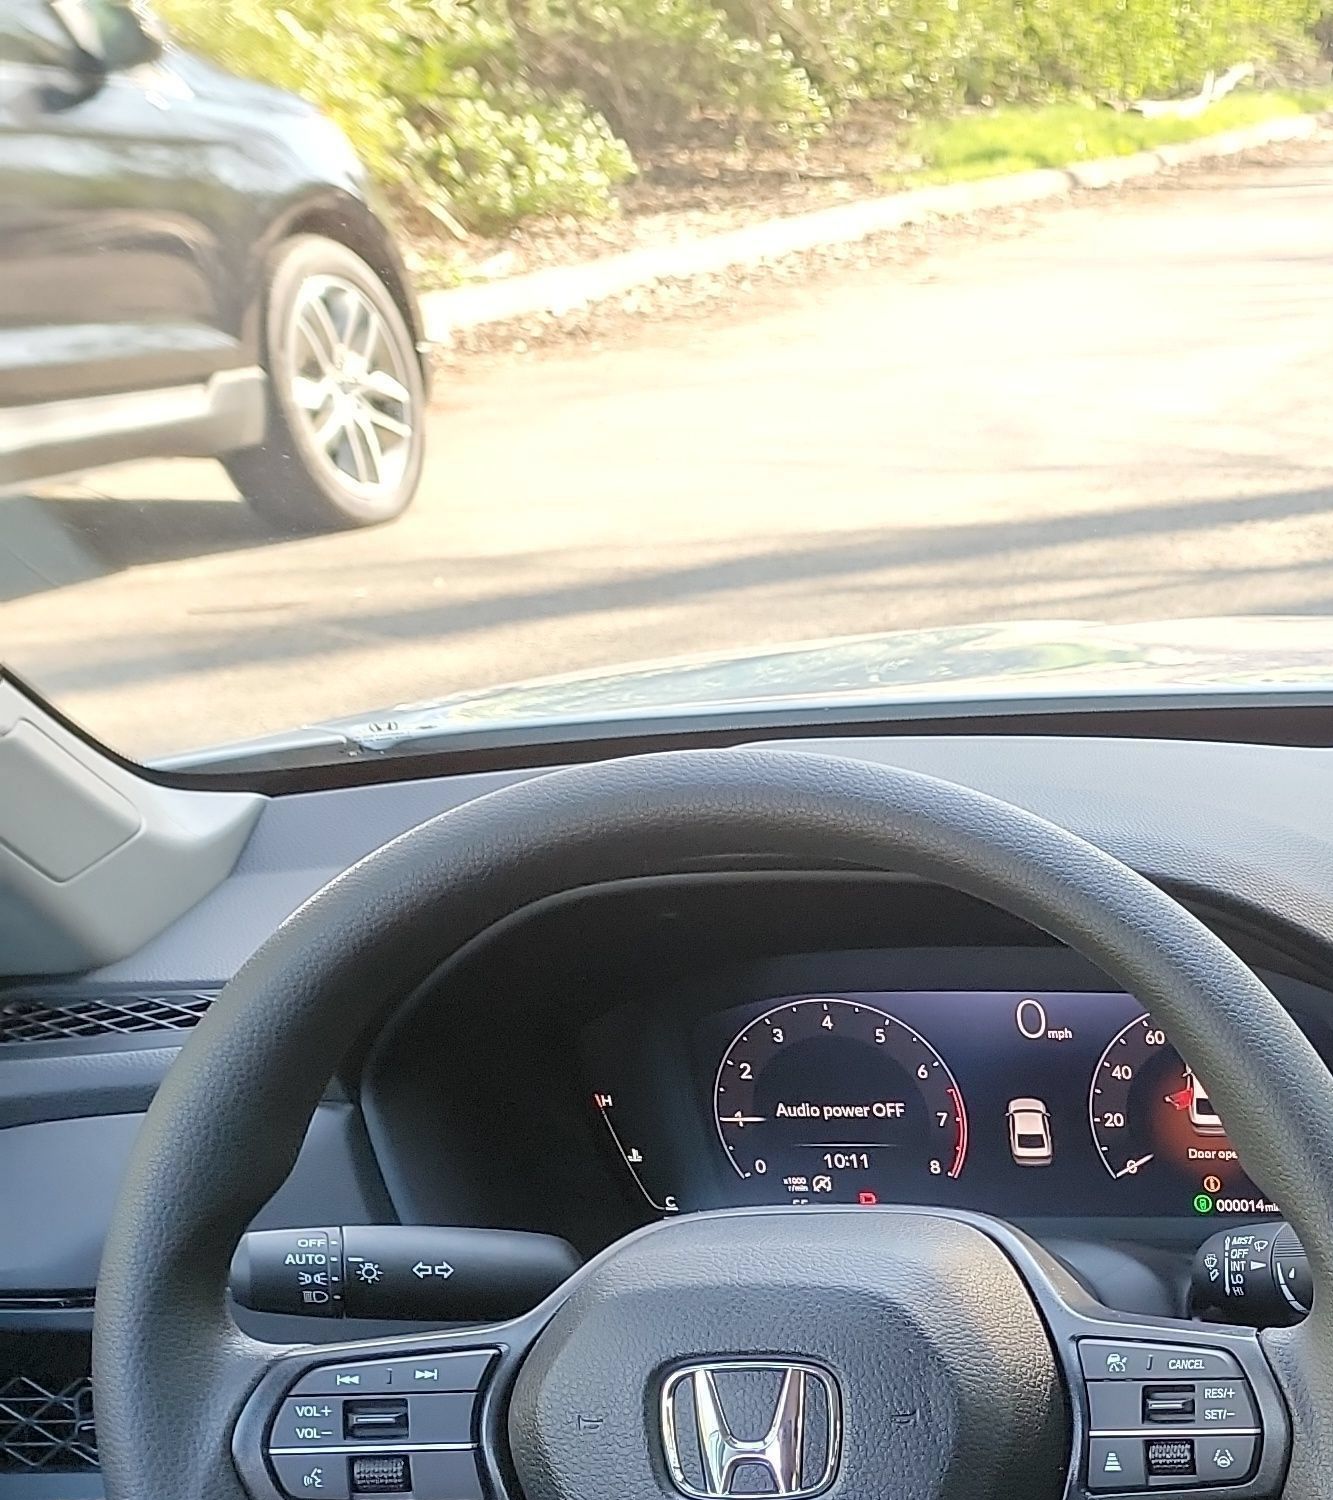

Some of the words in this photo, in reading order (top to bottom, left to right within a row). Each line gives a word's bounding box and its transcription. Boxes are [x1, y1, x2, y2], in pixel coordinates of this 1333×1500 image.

[821, 1015, 833, 1030] 4
[1015, 999, 1046, 1039] 0
[1047, 1028, 1073, 1041] mph
[772, 1028, 784, 1043] 3
[874, 1028, 886, 1043] 5
[1145, 1030, 1166, 1045] 60
[739, 1063, 753, 1079] 2
[917, 1064, 929, 1079] 6
[1111, 1065, 1133, 1080] 40
[601, 1095, 613, 1107] H
[775, 1103, 820, 1118] Audio
[823, 1104, 870, 1121] power
[872, 1103, 905, 1118] OFF
[936, 1112, 947, 1127] 7
[1104, 1112, 1125, 1128] 20
[823, 1153, 869, 1169] 10:11
[1187, 1148, 1216, 1159] Door
[754, 1159, 767, 1174] 0
[930, 1160, 941, 1174] 8
[297, 1238, 326, 1248] OFF
[284, 1253, 327, 1266] AUTO
[1230, 1248, 1249, 1259] OFF
[1230, 1260, 1247, 1272] INT
[1230, 1274, 1244, 1285] LO
[1167, 1358, 1206, 1370] CANCEL
